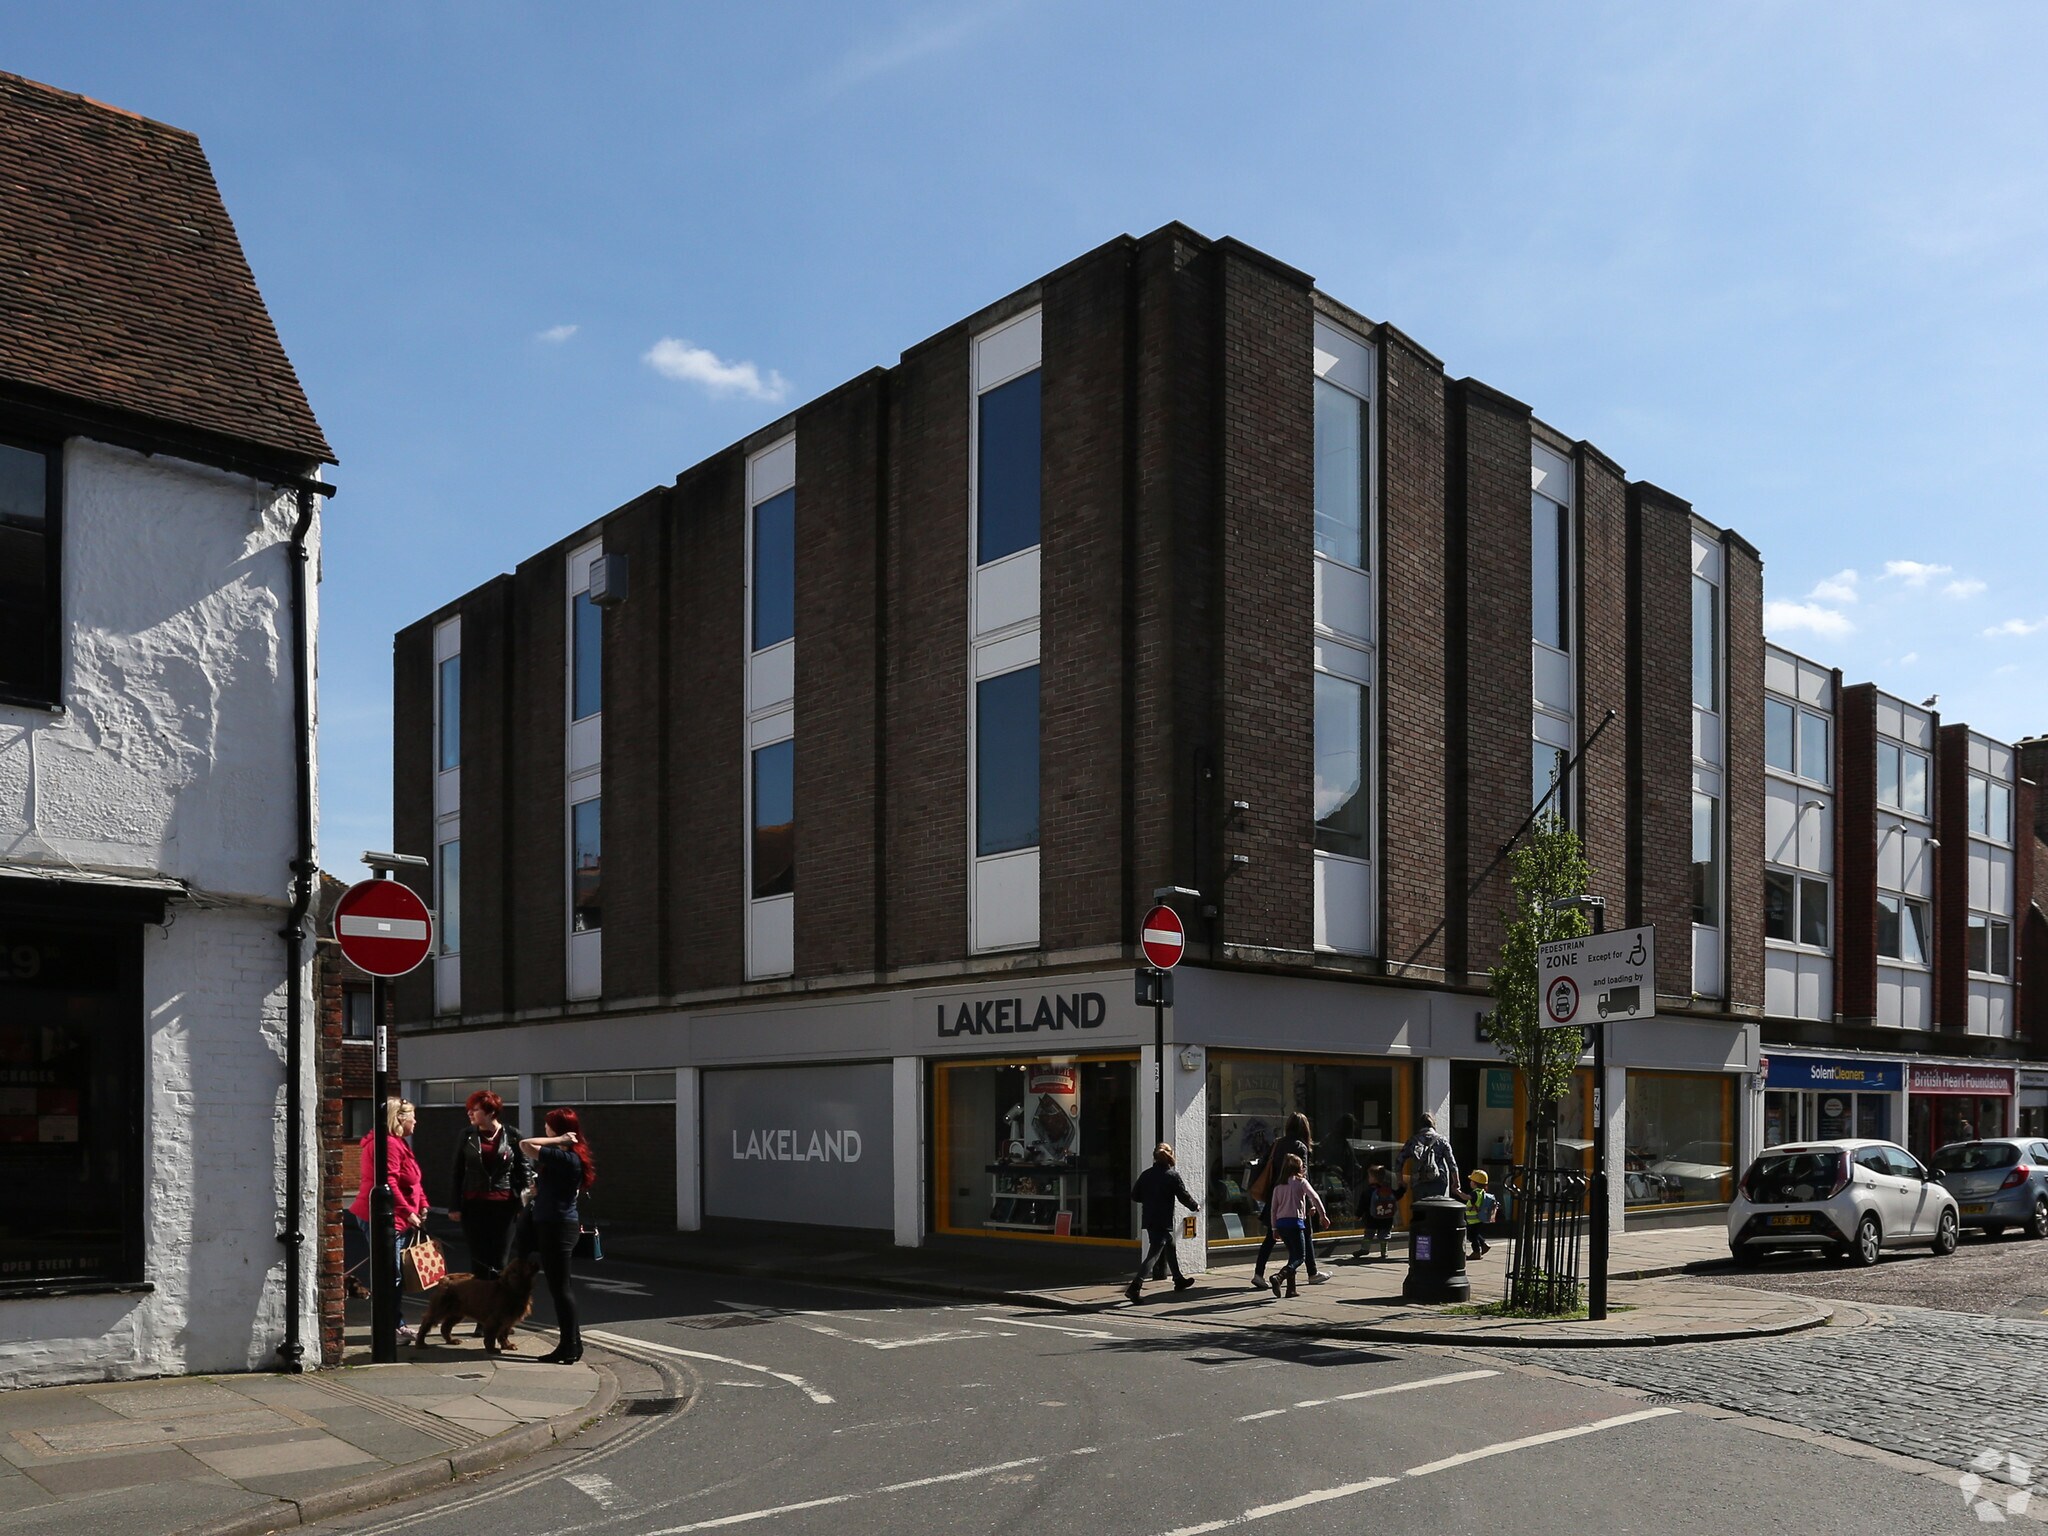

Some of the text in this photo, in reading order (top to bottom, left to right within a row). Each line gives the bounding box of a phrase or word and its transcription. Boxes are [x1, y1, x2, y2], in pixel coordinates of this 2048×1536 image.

[1540, 940, 1585, 955] PEDESTRIAN
[1546, 953, 1578, 969] ZONE
[1587, 950, 1623, 963] Except for
[1593, 972, 1644, 987] and loading by
[938, 992, 1106, 1037] LAKELAND
[1914, 1070, 2009, 1090] British Heart Foundation
[732, 1129, 862, 1163] LAKELAND
[2, 1261, 32, 1272] OPEN
[38, 1258, 72, 1271] EVERY
